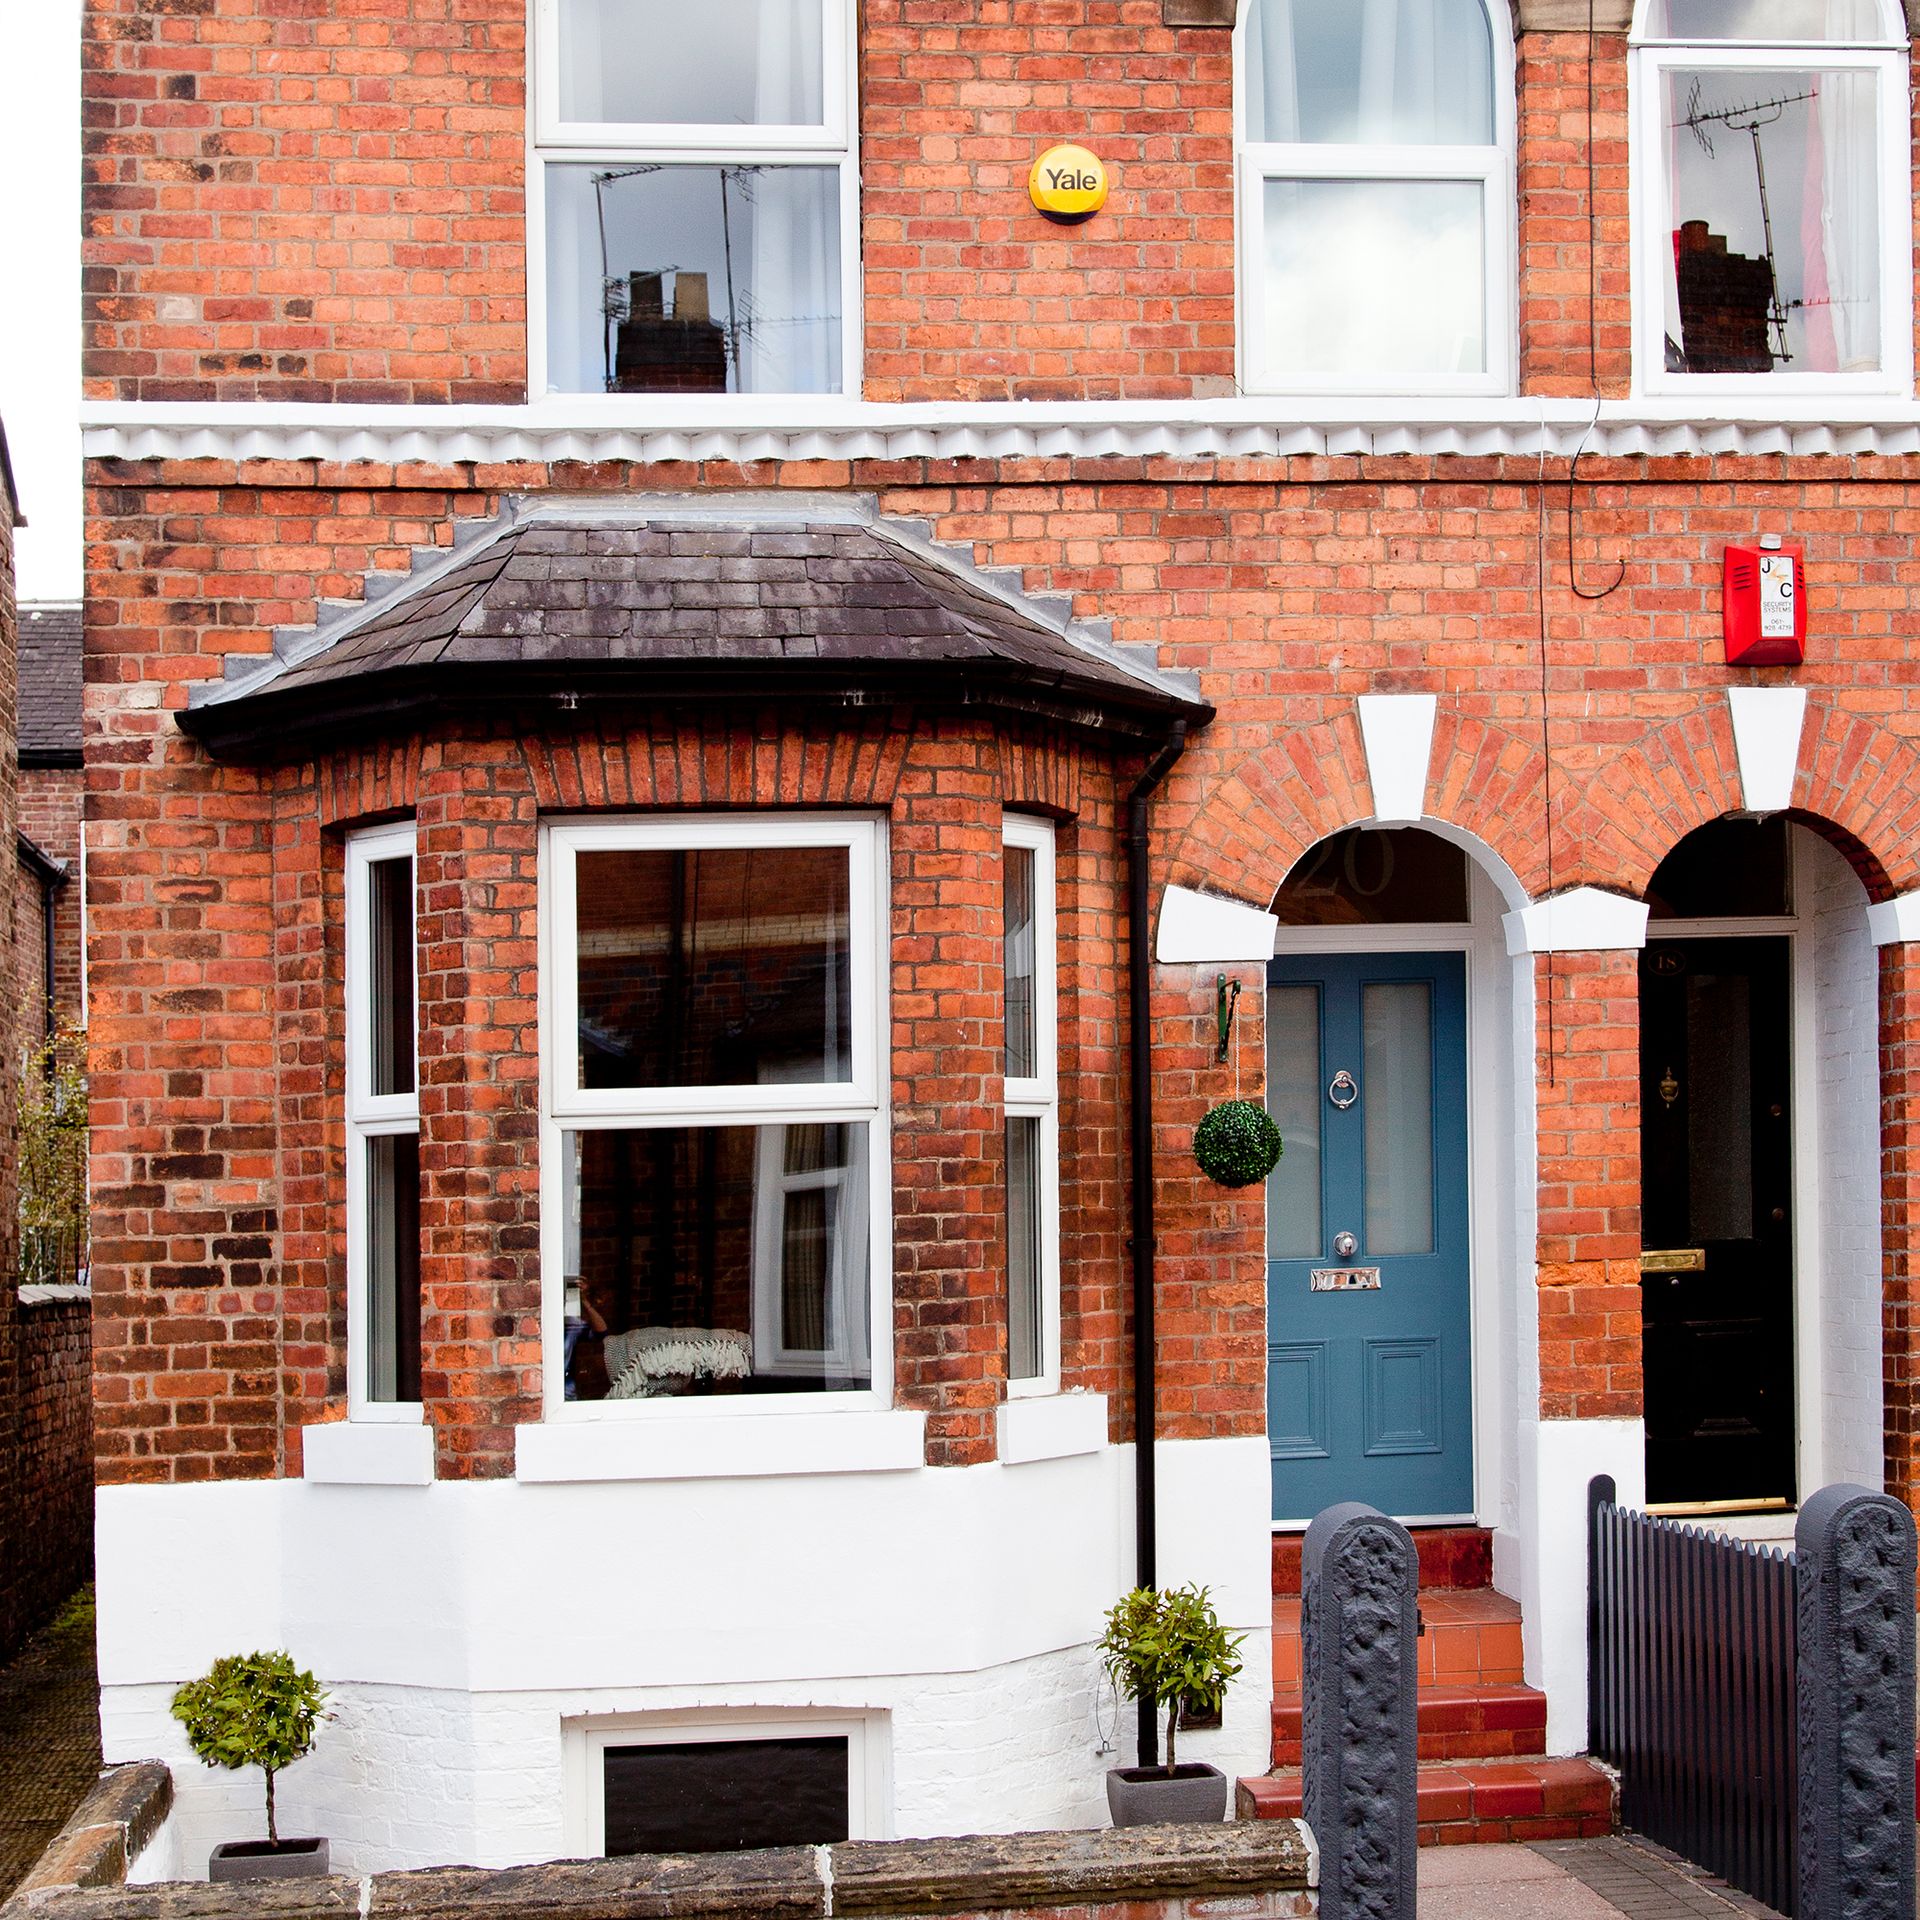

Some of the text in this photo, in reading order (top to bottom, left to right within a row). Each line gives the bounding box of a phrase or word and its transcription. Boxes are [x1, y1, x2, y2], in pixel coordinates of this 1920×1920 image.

[1046, 168, 1097, 191] Yale
[1762, 558, 1771, 574] J
[1780, 582, 1792, 598] C
[1292, 827, 1395, 897] 20
[1658, 955, 1677, 970] 18
